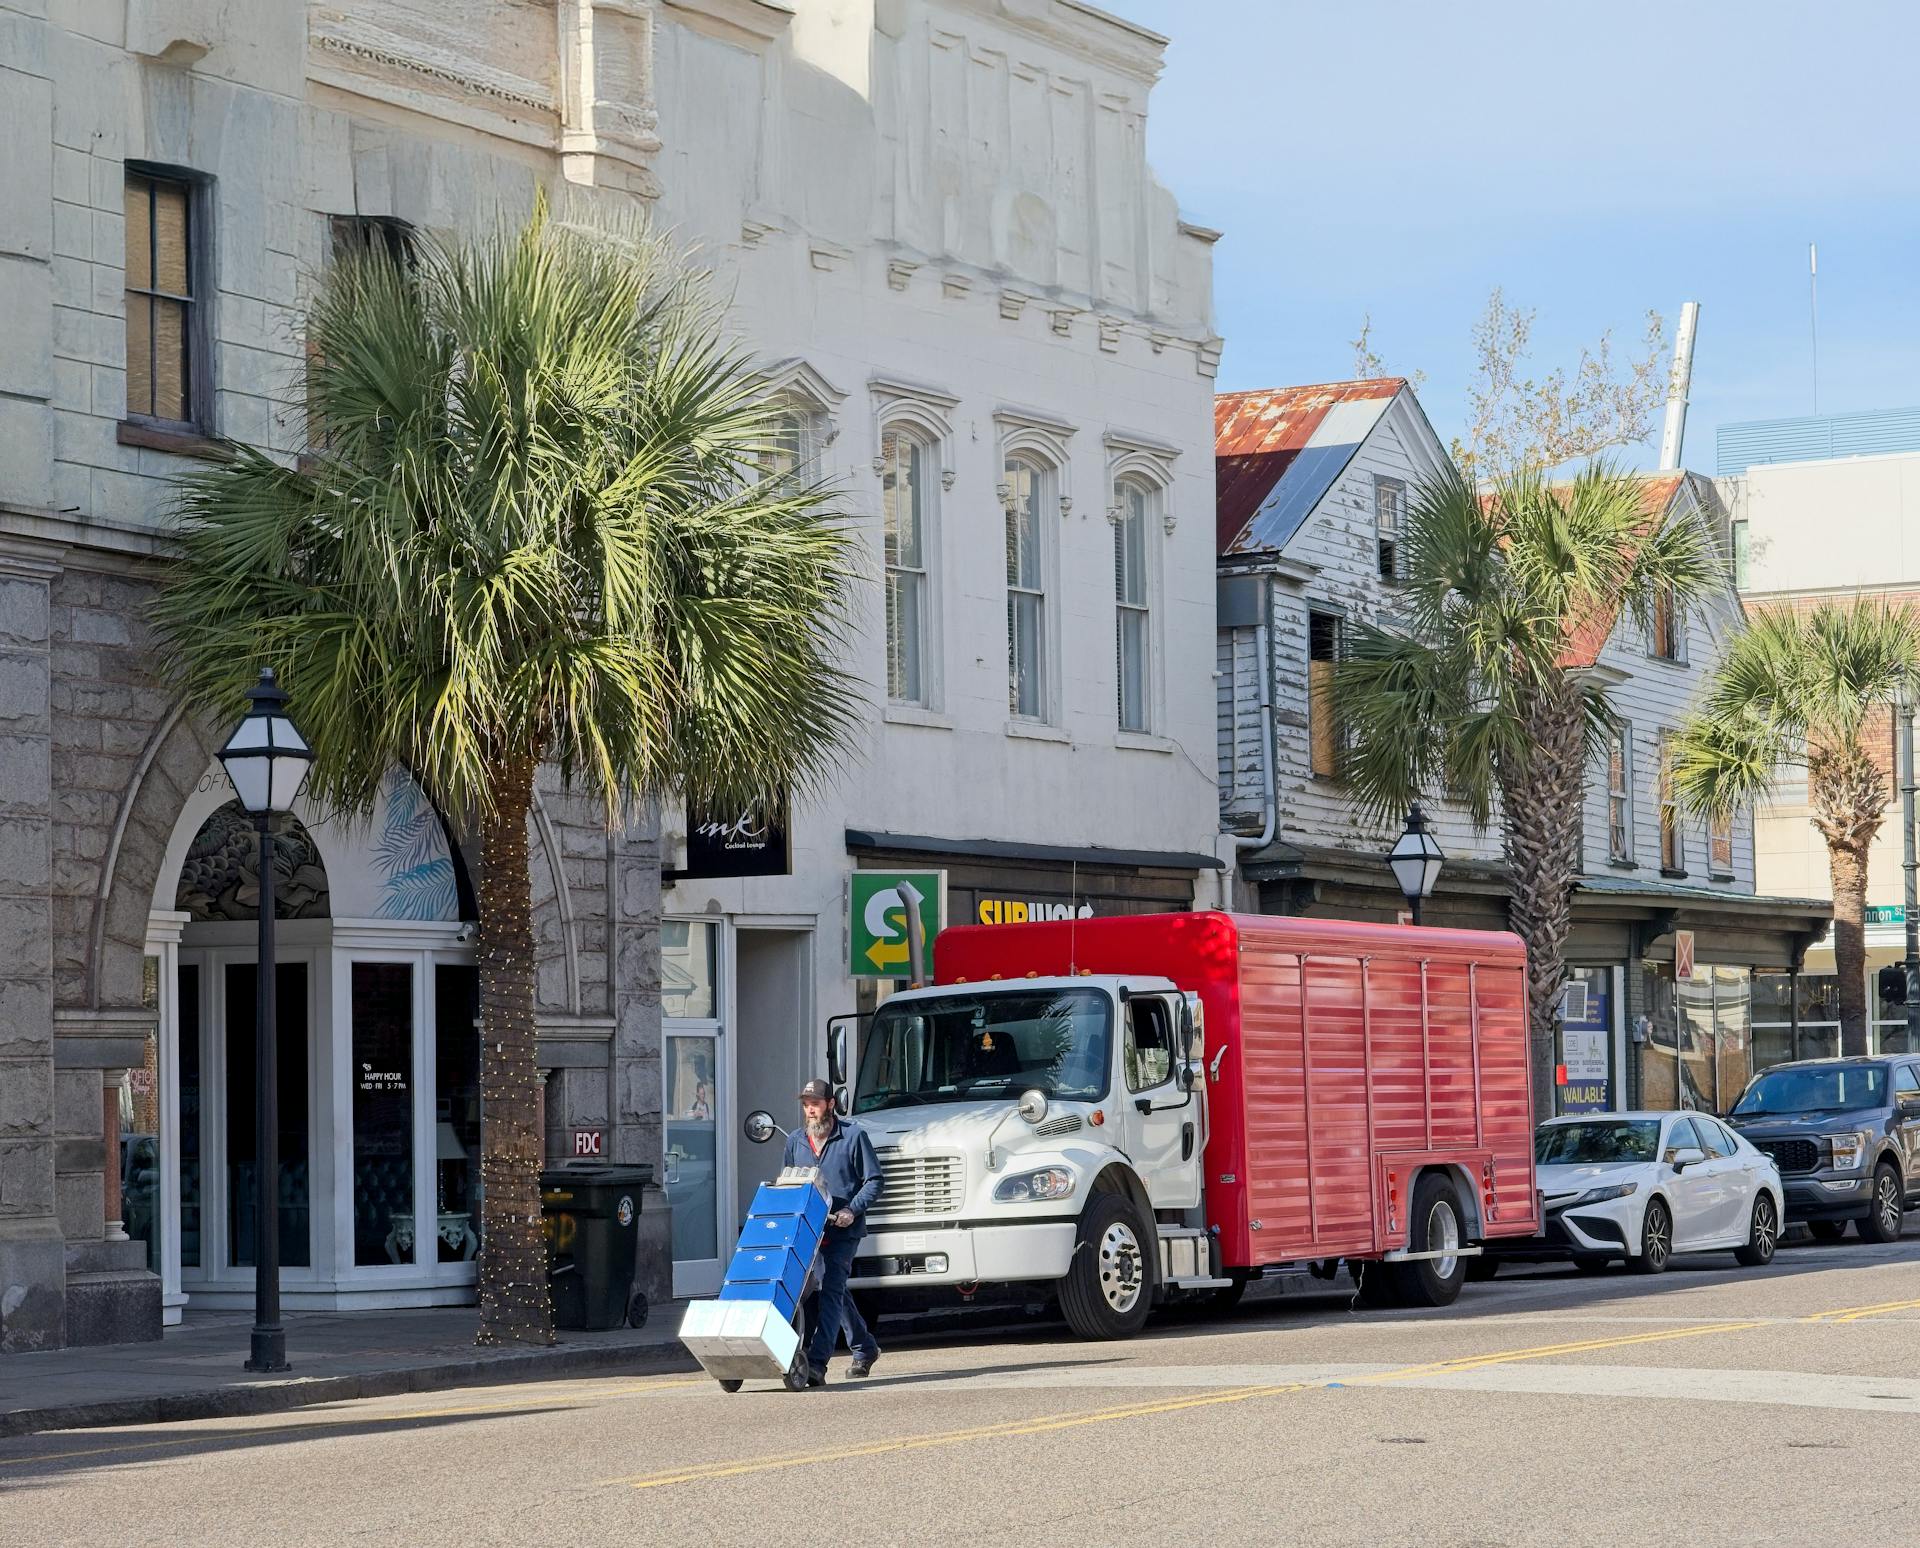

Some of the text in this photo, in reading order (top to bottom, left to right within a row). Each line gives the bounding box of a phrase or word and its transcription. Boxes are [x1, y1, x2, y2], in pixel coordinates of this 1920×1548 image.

[695, 796, 766, 842] ink
[725, 842, 766, 850] Cocktail Lounge
[1863, 910, 1892, 921] nnon
[364, 1072, 402, 1081] HAPPY HOUR
[1564, 1087, 1606, 1104] AVAILABLE
[575, 1132, 600, 1155] FDC
